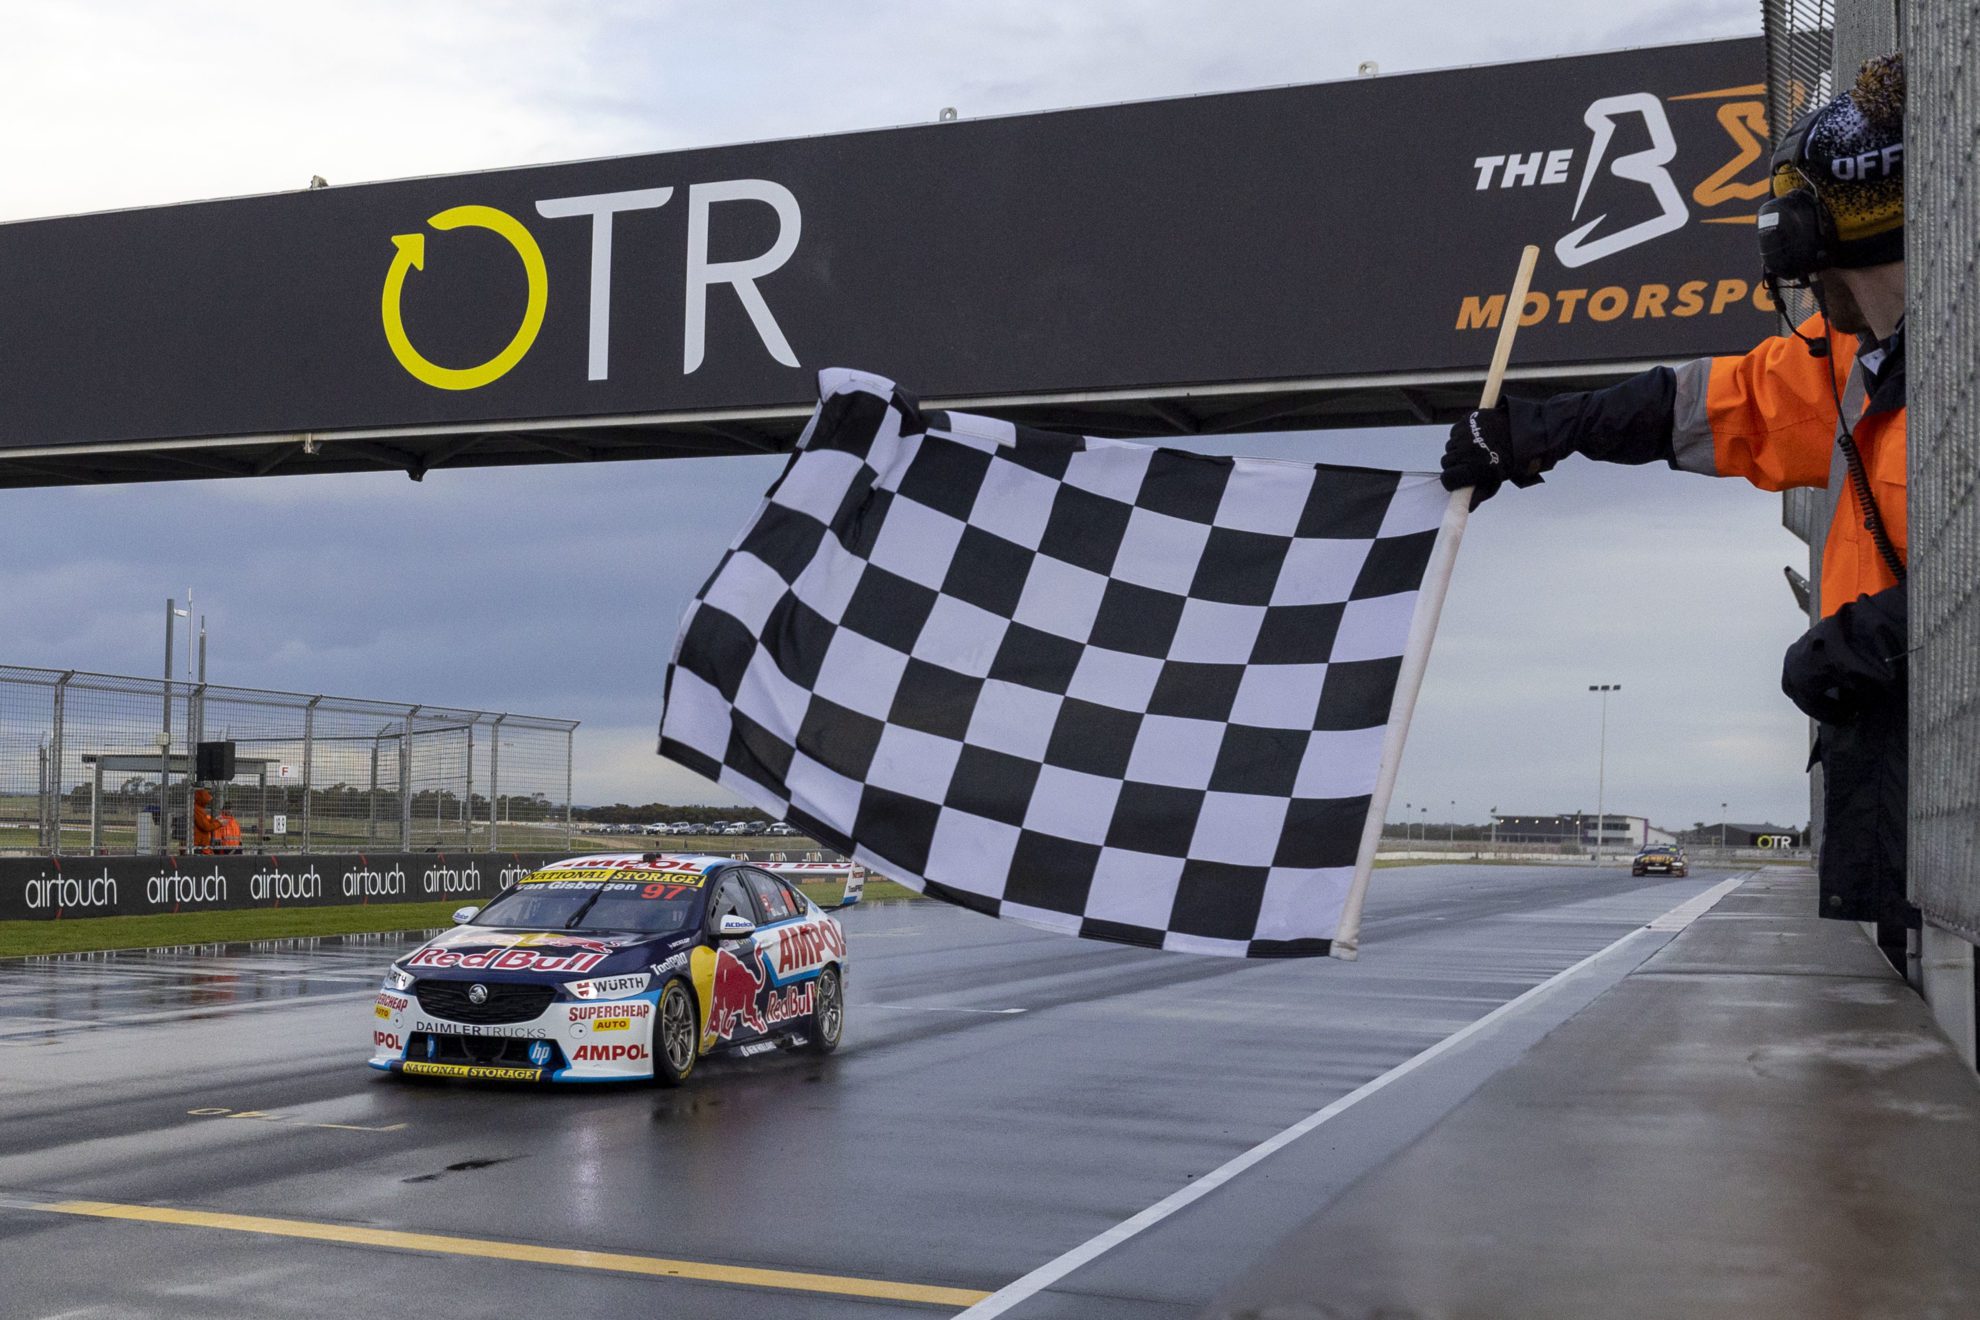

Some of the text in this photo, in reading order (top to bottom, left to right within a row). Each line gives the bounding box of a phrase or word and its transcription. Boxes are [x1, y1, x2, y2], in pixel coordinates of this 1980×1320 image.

[1474, 149, 1574, 191] THE
[1832, 143, 1903, 181] OFF
[382, 178, 802, 391] OTR
[1757, 835, 1792, 849] OTR
[25, 868, 117, 908] airtouch
[147, 865, 227, 903] airtouch
[250, 864, 321, 899] airtouch
[343, 862, 406, 896] airtouch
[423, 861, 481, 892] airtouch
[525, 870, 700, 885] NATIONAL STORAGE
[548, 882, 637, 892] Gisbergen
[641, 884, 687, 900] 97
[778, 918, 847, 974] AMPOL
[409, 948, 609, 973] Red Bull
[650, 952, 688, 976] ToolPRO
[593, 977, 644, 993] WÜRTH
[569, 1004, 650, 1022] SUPERCHEAP
[596, 1020, 627, 1029] AUTO
[416, 1021, 547, 1039] DAIMLER TRUCKS
[531, 1041, 551, 1066] hp
[572, 1044, 649, 1061] AMPOL
[405, 1062, 536, 1081] NATIONAL STORAGE
